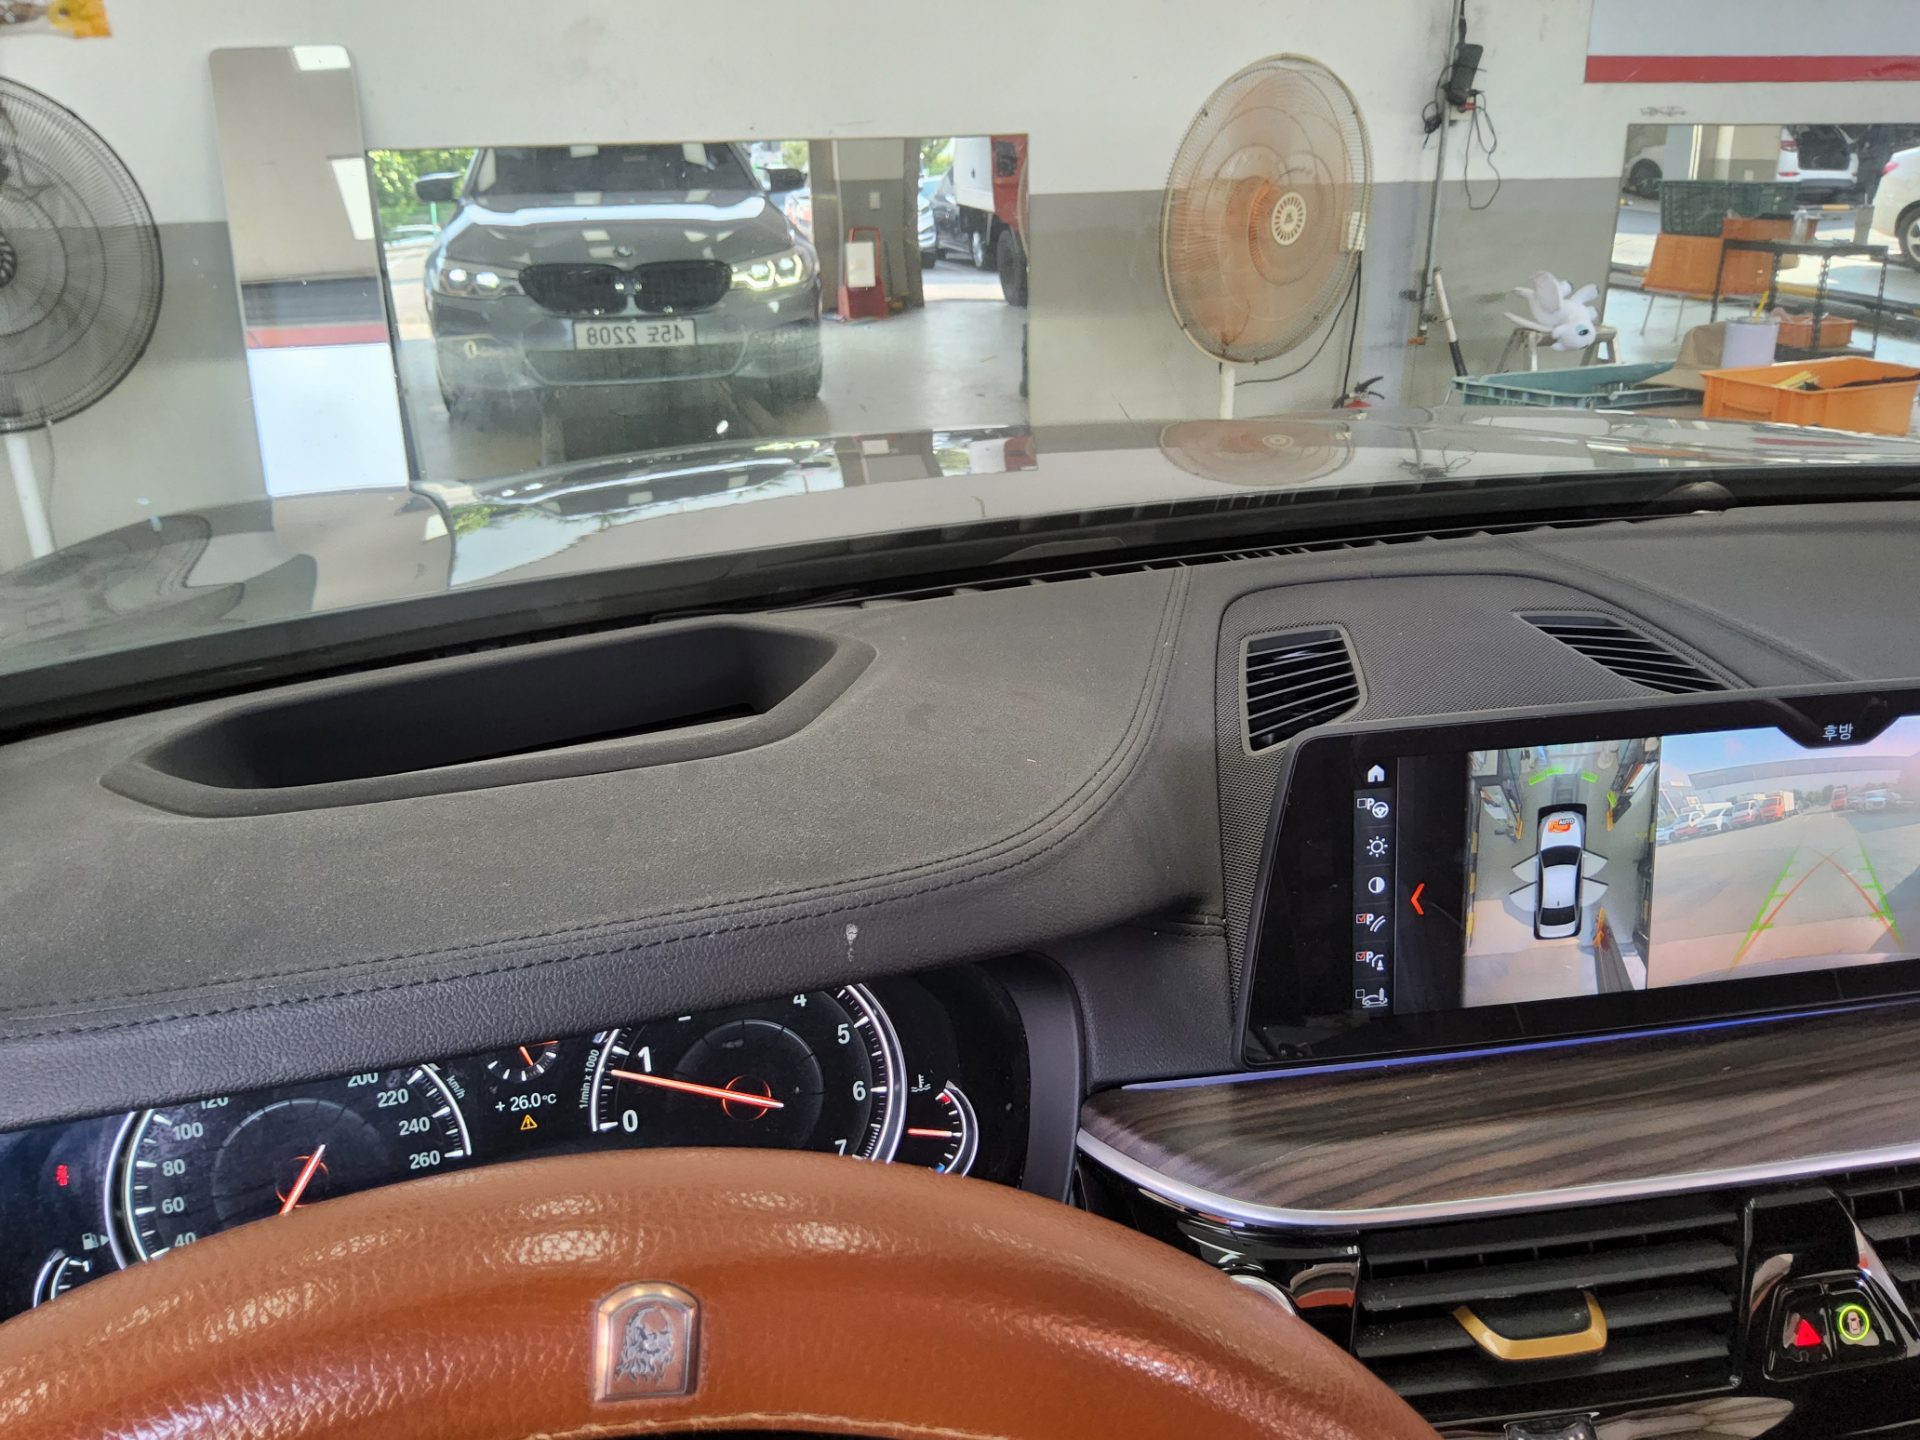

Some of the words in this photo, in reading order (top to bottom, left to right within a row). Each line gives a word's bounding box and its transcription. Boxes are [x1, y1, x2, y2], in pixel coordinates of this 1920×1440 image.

[1822, 723, 1854, 742] 후방
[837, 1023, 851, 1045] 5
[584, 1049, 600, 1073] 1000
[637, 1046, 652, 1073] 1
[446, 1075, 466, 1100] km/h
[852, 1080, 867, 1102] 6
[376, 1088, 409, 1108] 220
[398, 1116, 431, 1136] 240
[622, 1109, 639, 1133] 0
[172, 1121, 204, 1142] 100
[834, 1138, 848, 1157] 7
[162, 1158, 186, 1177] 80
[408, 1150, 441, 1170] 260
[161, 1196, 185, 1215] 60
[174, 1231, 197, 1249] 40
